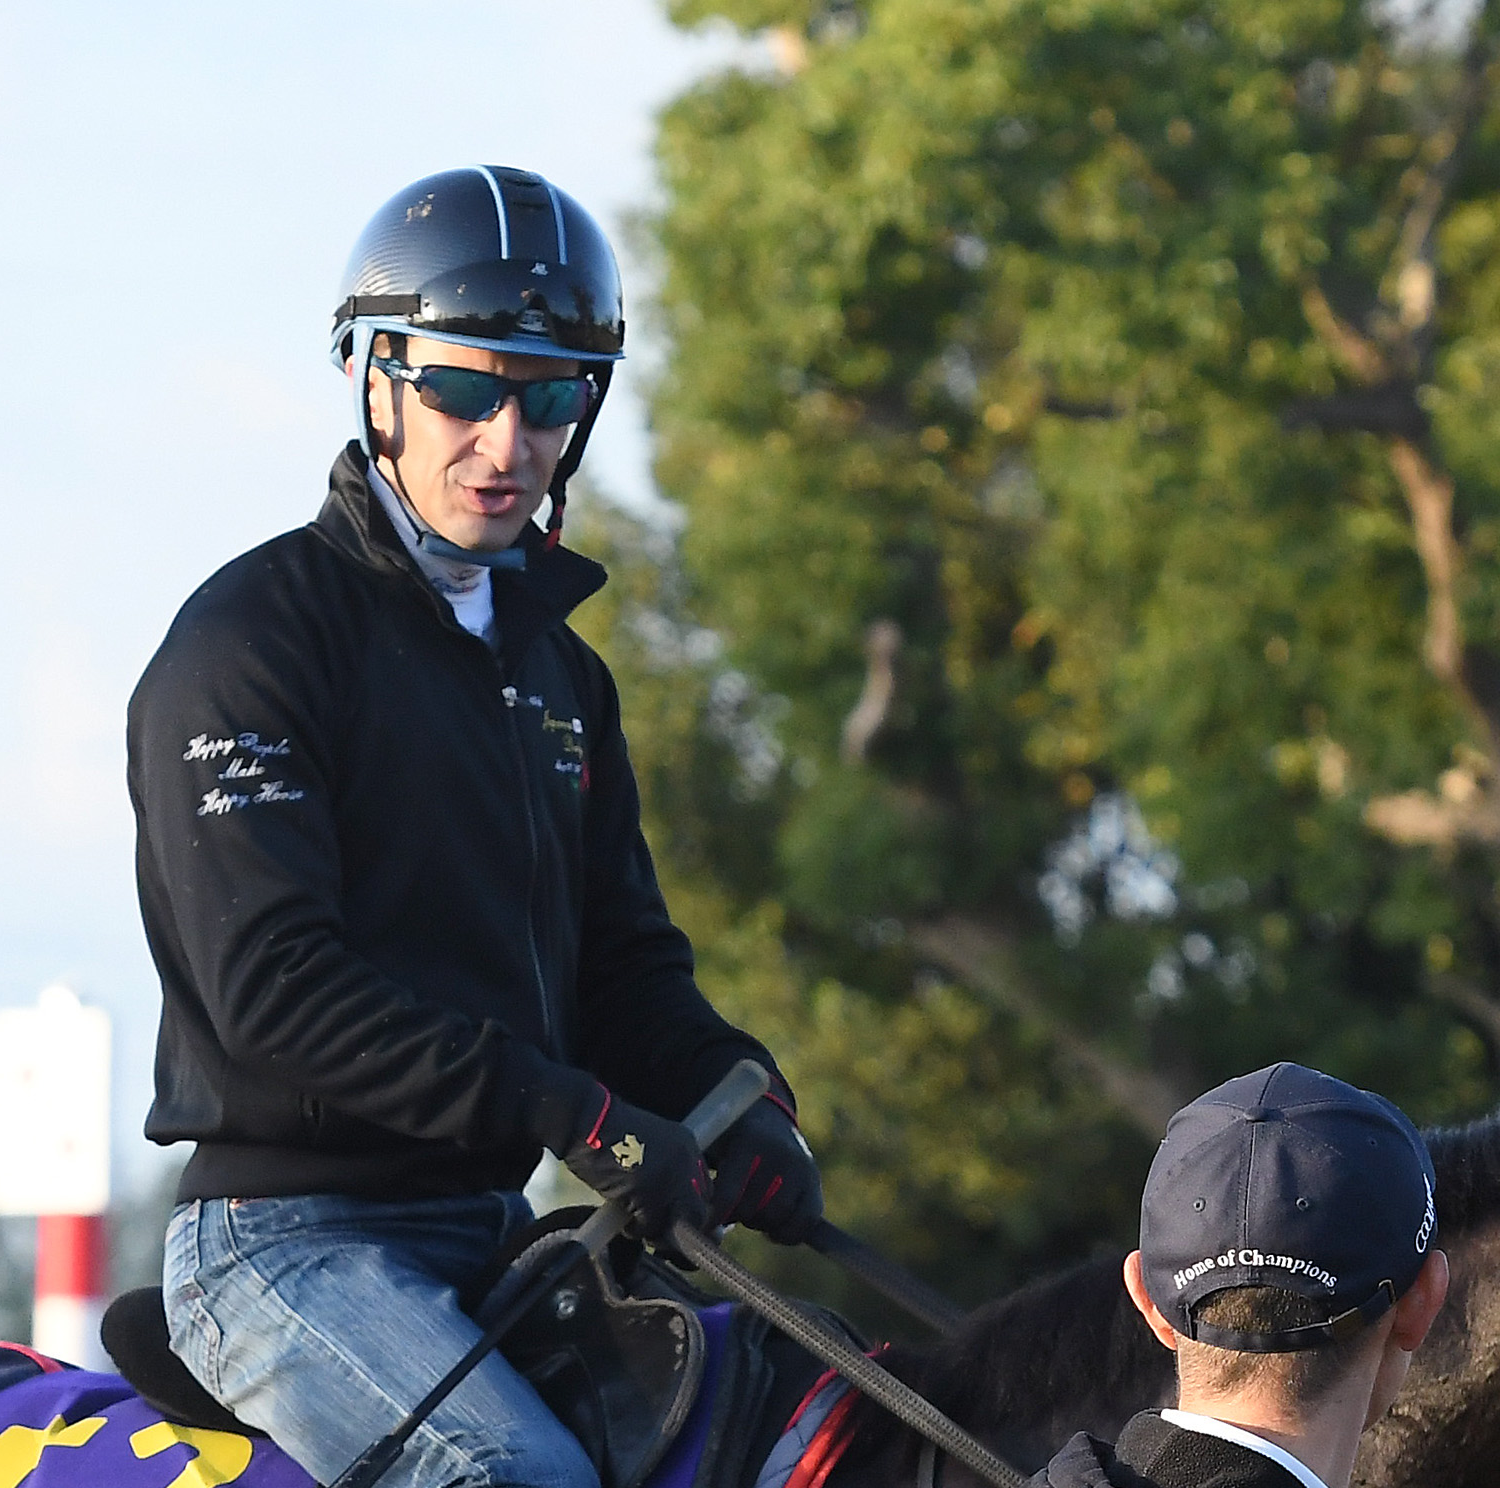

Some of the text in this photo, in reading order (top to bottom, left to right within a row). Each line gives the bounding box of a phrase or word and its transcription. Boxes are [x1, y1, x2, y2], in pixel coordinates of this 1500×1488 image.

[182, 733, 236, 761] Happy
[218, 757, 266, 779] Make
[197, 788, 250, 816] Happy
[1173, 1249, 1338, 1290] Home of Champions
